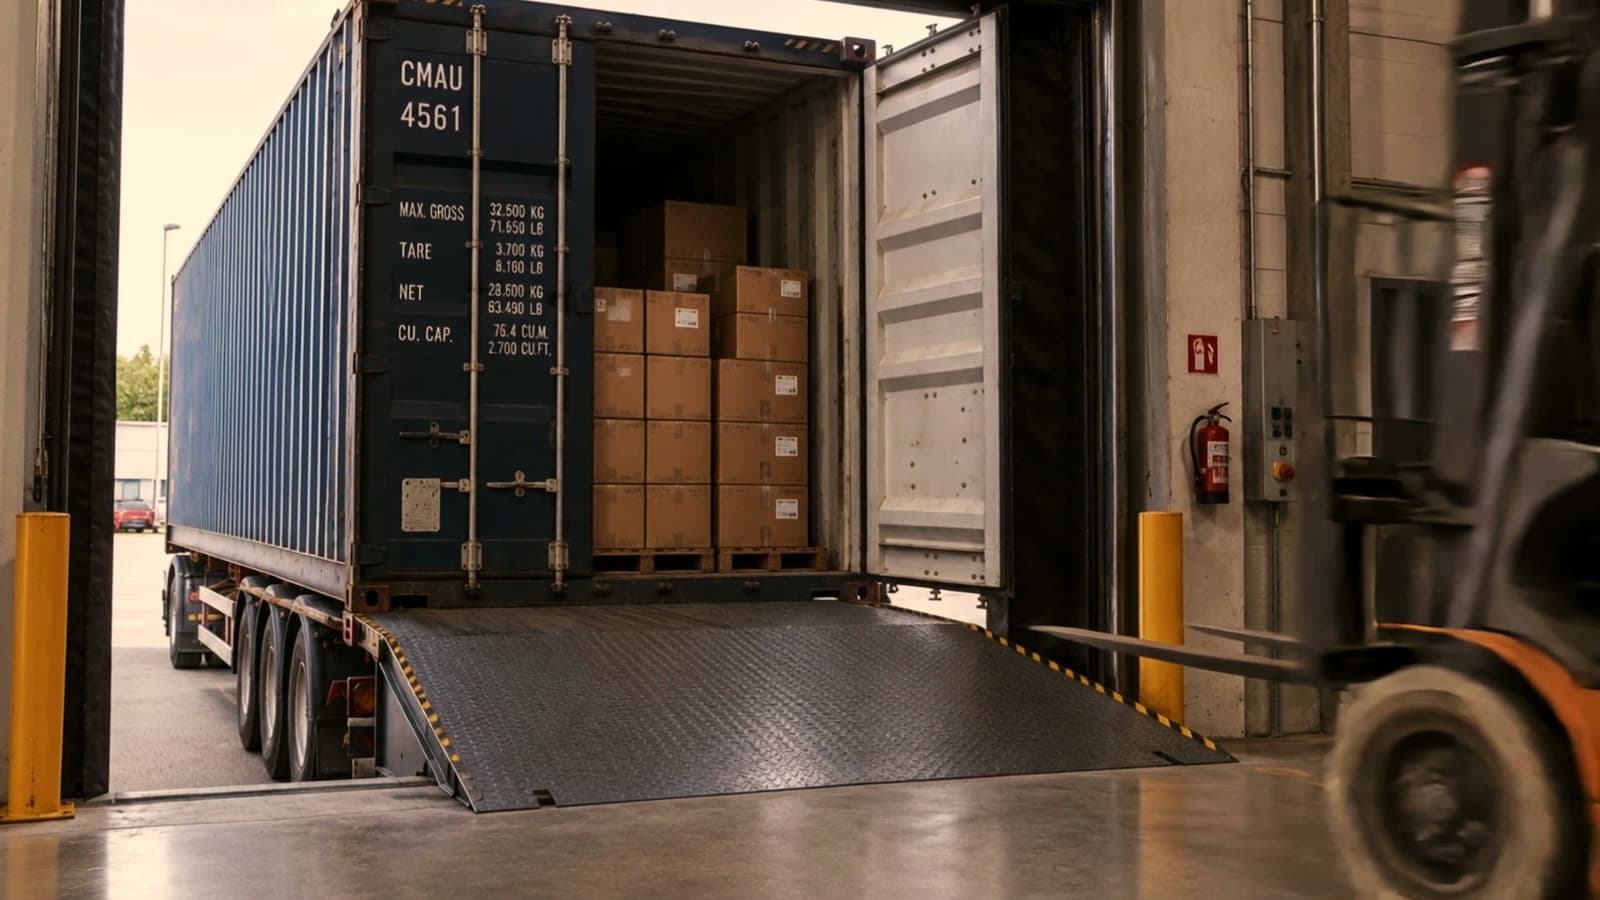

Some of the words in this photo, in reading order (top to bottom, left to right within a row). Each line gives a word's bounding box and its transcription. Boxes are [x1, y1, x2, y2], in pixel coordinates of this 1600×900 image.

[400, 59, 463, 92] CMAU
[400, 101, 461, 132] 4561
[400, 201, 426, 218] MAX.
[430, 203, 465, 221] GROSS
[490, 202, 526, 219] 32.500
[531, 206, 545, 219] KG
[490, 219, 525, 235] 71.650
[530, 222, 544, 236] LB
[400, 241, 432, 260] TARE
[496, 242, 525, 257] 3.700
[531, 244, 545, 258] KG
[530, 261, 544, 275] LB
[400, 283, 424, 301] NET
[530, 285, 544, 299] KG
[530, 302, 543, 316] LB
[398, 324, 420, 342] CU.
[425, 325, 453, 343] CAP.
[493, 323, 517, 338] 76.4
[488, 340, 517, 355] 2.700
